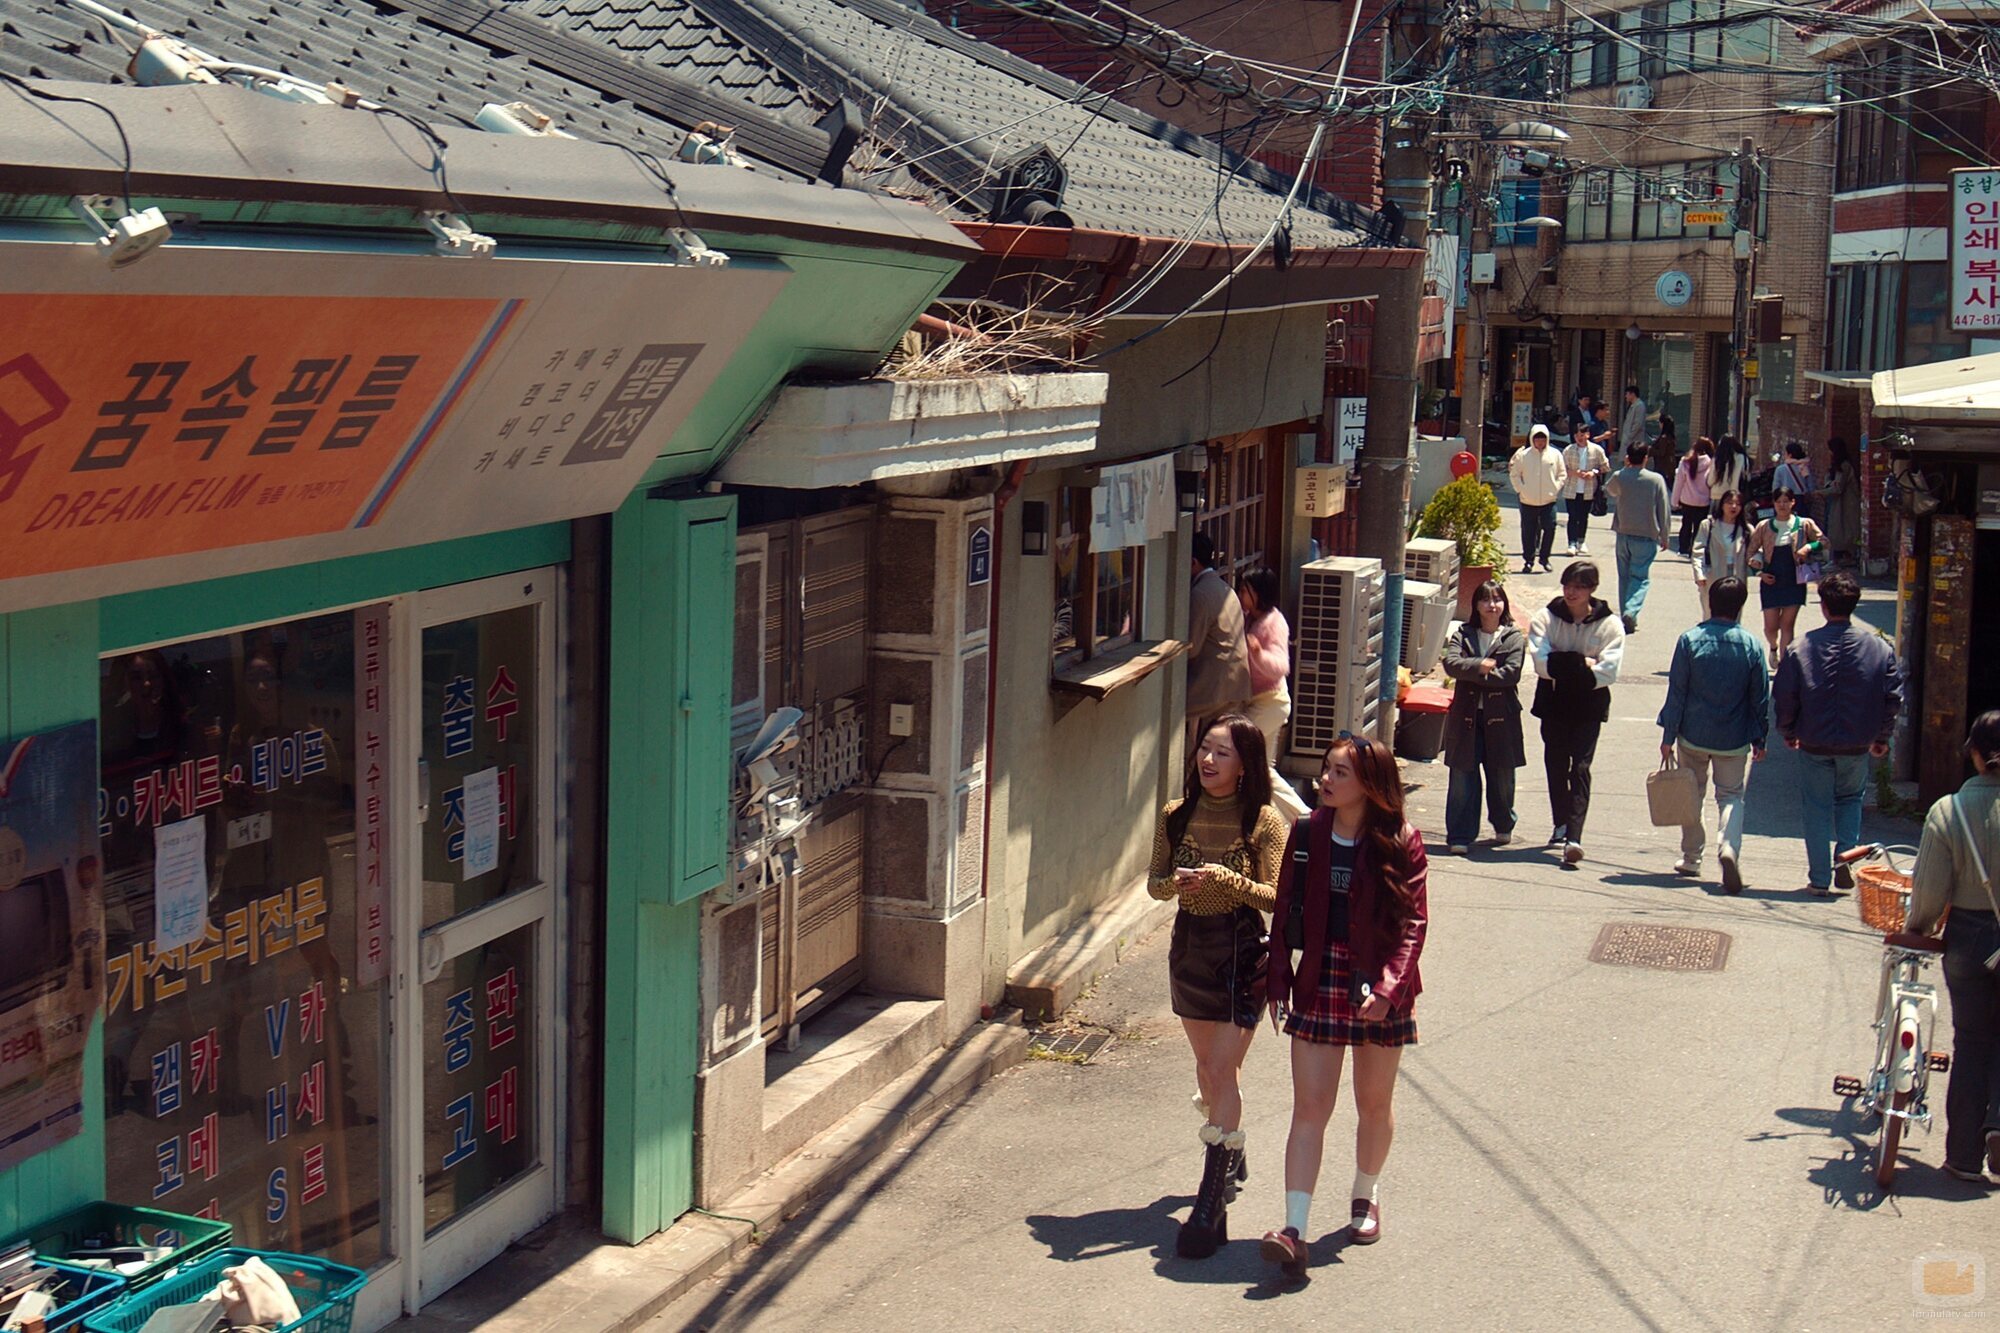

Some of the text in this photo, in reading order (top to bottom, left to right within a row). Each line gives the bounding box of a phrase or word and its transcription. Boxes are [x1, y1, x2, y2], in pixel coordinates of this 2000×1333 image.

[520, 379, 600, 407] 캠코더
[545, 347, 624, 372] 카메라
[616, 357, 687, 400] 필름
[70, 354, 420, 472] 꿈속필름
[474, 445, 553, 473] 카세트
[498, 412, 576, 439] 비디오
[583, 404, 652, 450] 가전
[24, 481, 178, 533] DREAM
[166, 473, 264, 517] FILM
[134, 755, 223, 827] 카세트
[252, 728, 327, 792] 테이프
[365, 618, 381, 965] 컴퓨터 누수탐지기 보유
[106, 877, 328, 1016] 가전수리전문
[296, 981, 327, 1206] 카세트
[442, 987, 478, 1170] 중고
[485, 967, 519, 1144] 판매
[265, 998, 290, 1224] VHS
